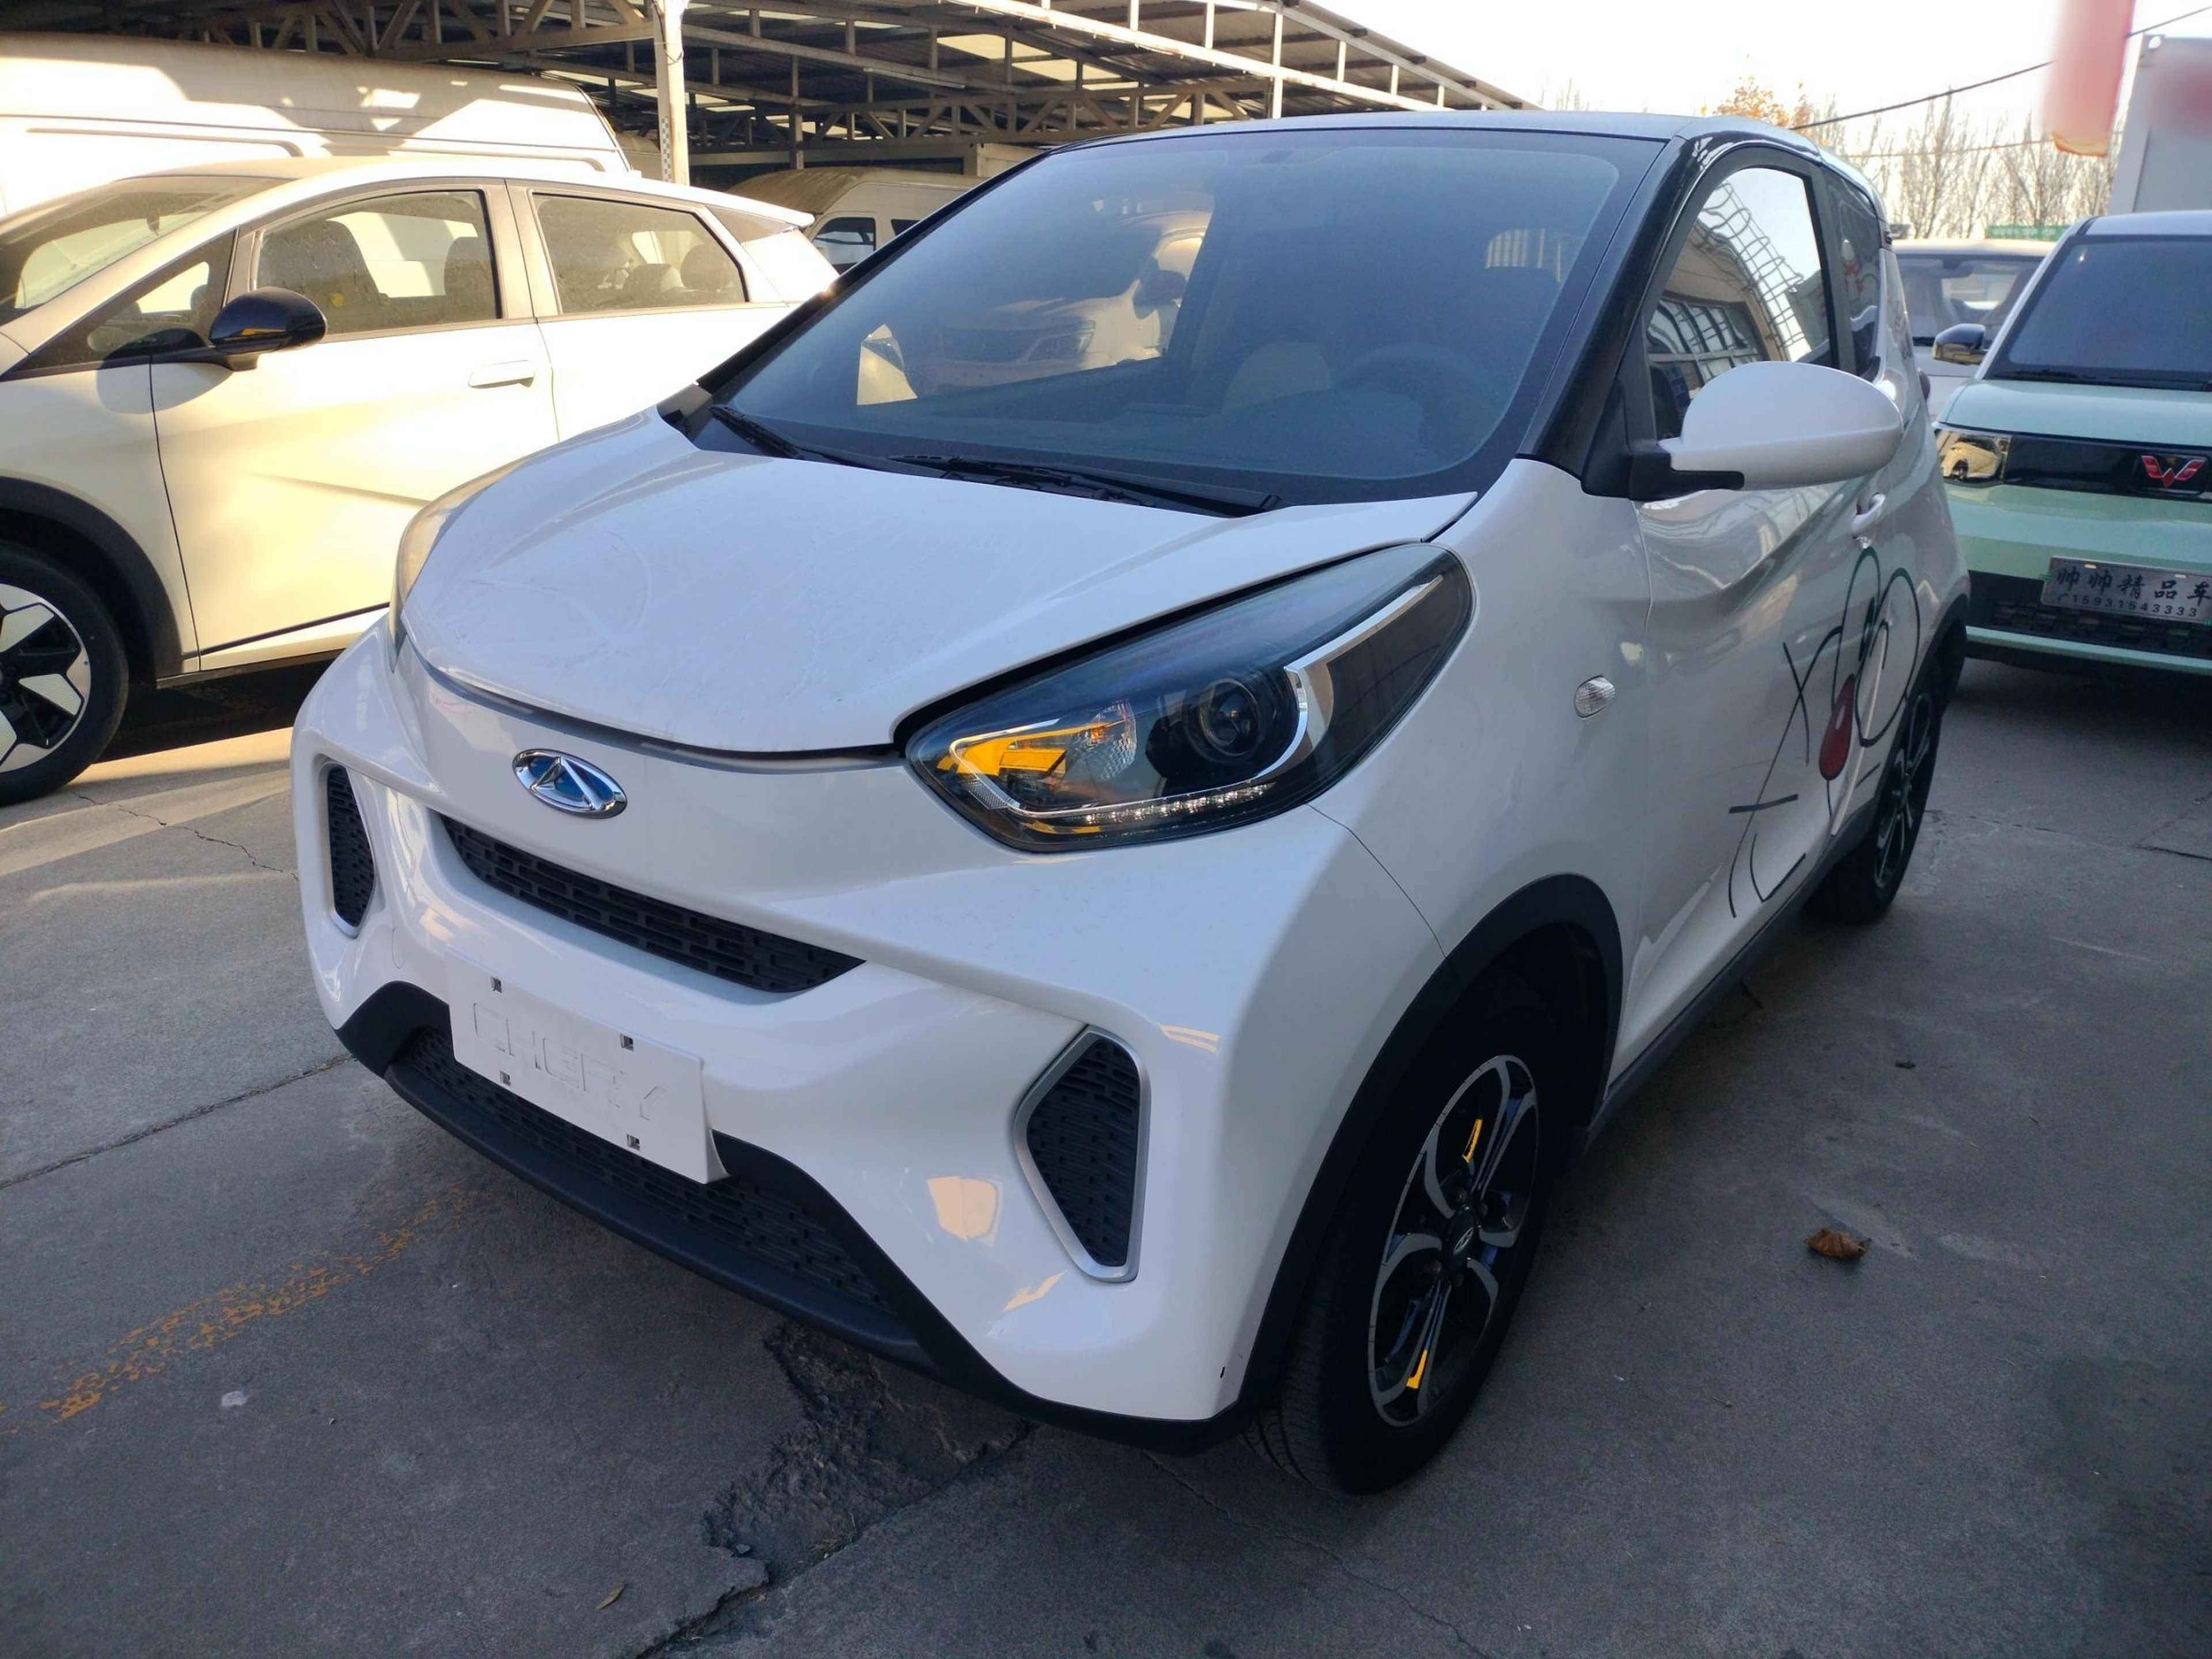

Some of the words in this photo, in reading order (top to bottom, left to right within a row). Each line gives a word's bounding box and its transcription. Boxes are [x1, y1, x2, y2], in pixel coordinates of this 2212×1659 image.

[2057, 566, 2211, 606] 帅帅精品车
[2072, 594, 2197, 617] 15931543333
[473, 1002, 668, 1121] CHERY
